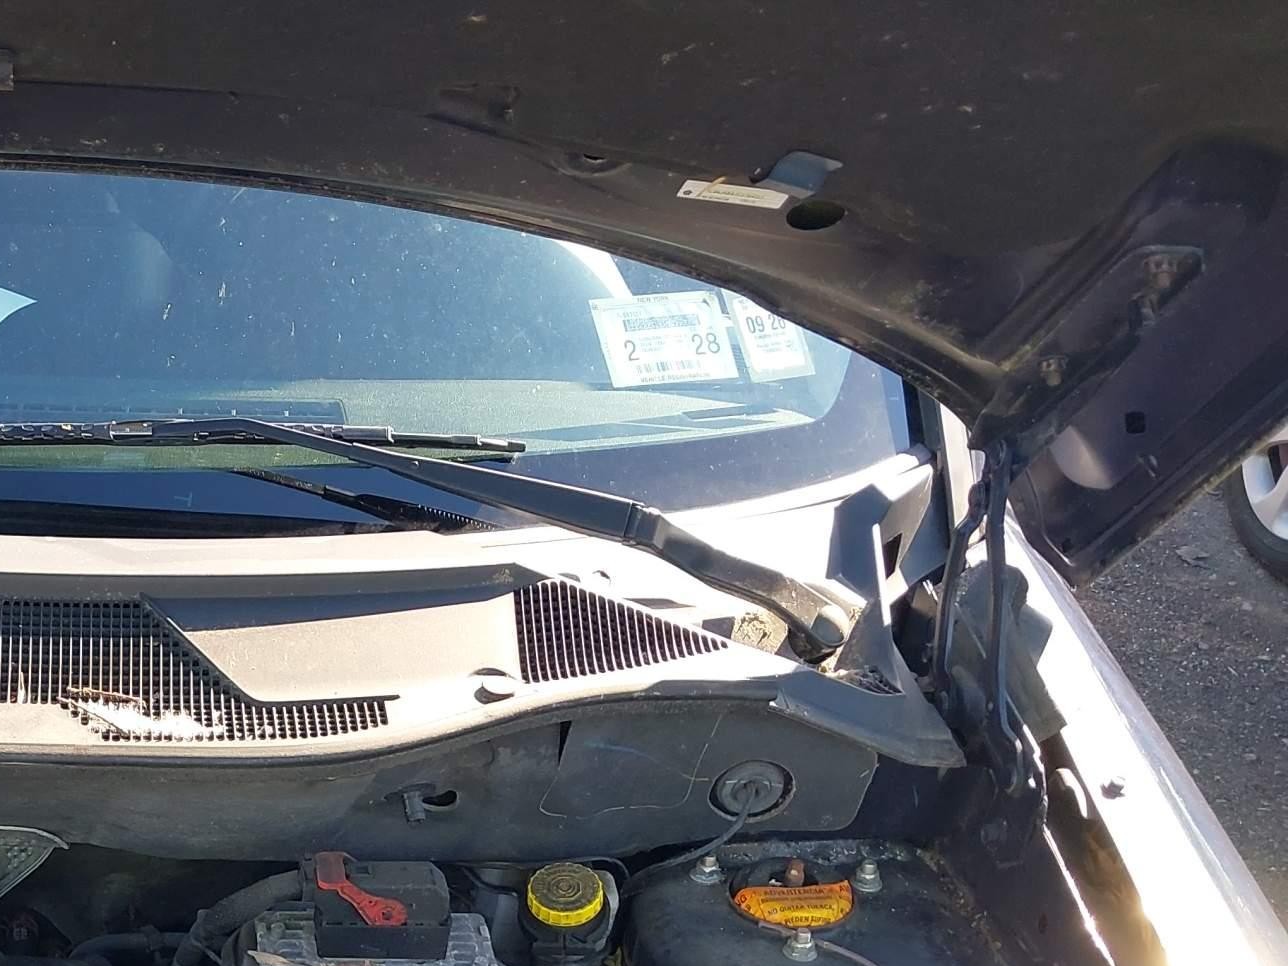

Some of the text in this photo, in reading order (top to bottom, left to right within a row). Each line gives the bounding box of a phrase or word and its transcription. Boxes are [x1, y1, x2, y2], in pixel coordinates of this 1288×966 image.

[746, 315, 765, 334] 09
[624, 340, 640, 361] 2
[691, 332, 721, 355] 28
